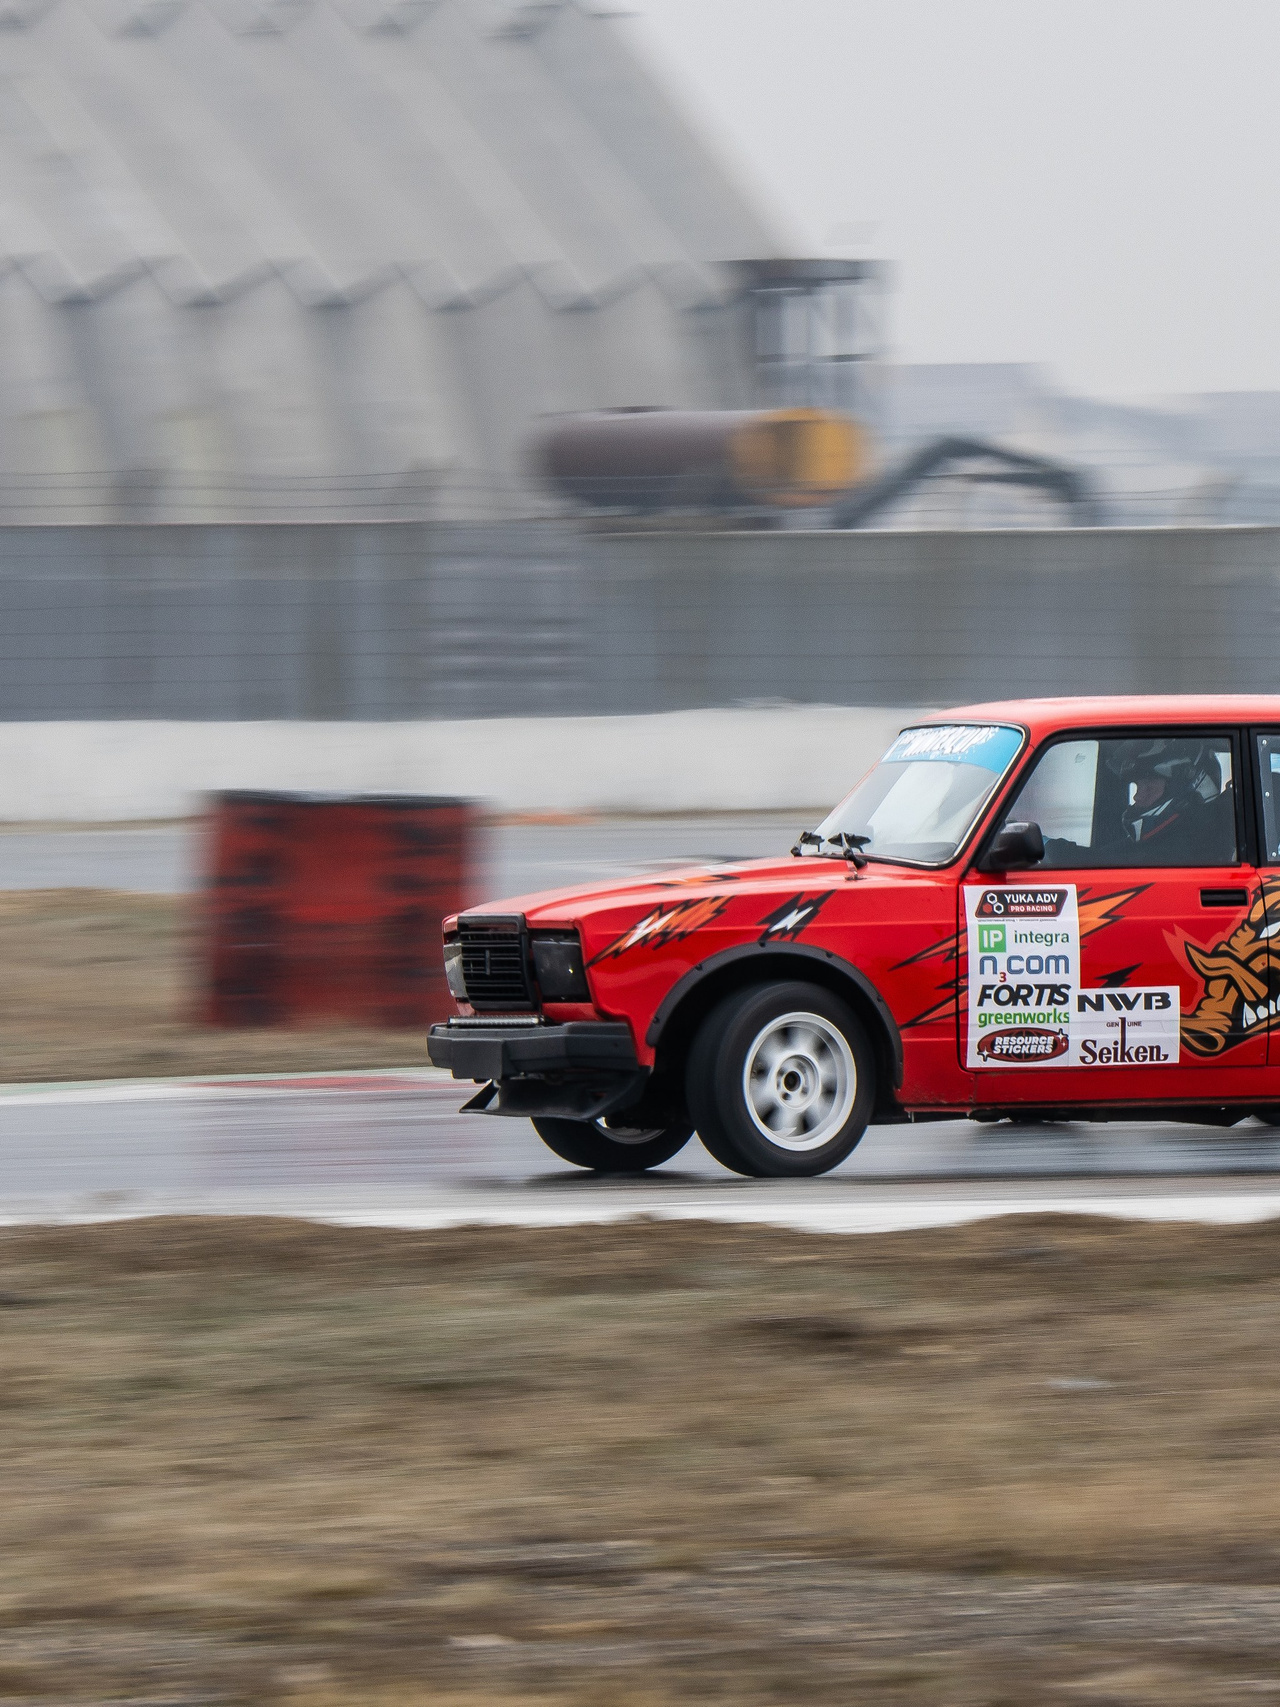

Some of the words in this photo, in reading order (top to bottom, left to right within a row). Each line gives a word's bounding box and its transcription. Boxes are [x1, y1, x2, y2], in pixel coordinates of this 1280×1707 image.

[1004, 893, 1034, 904] YUKA
[1036, 893, 1058, 903] ADV
[983, 930, 1003, 948] IP
[1014, 930, 1069, 947] integra
[977, 984, 1072, 1006] FORTIS
[1077, 992, 1172, 1012] NWB
[978, 1008, 1070, 1028] greenworks
[993, 1045, 1054, 1055] STICKERS
[995, 1036, 1055, 1045] RESOURCE
[1079, 1017, 1169, 1065] Seiken
